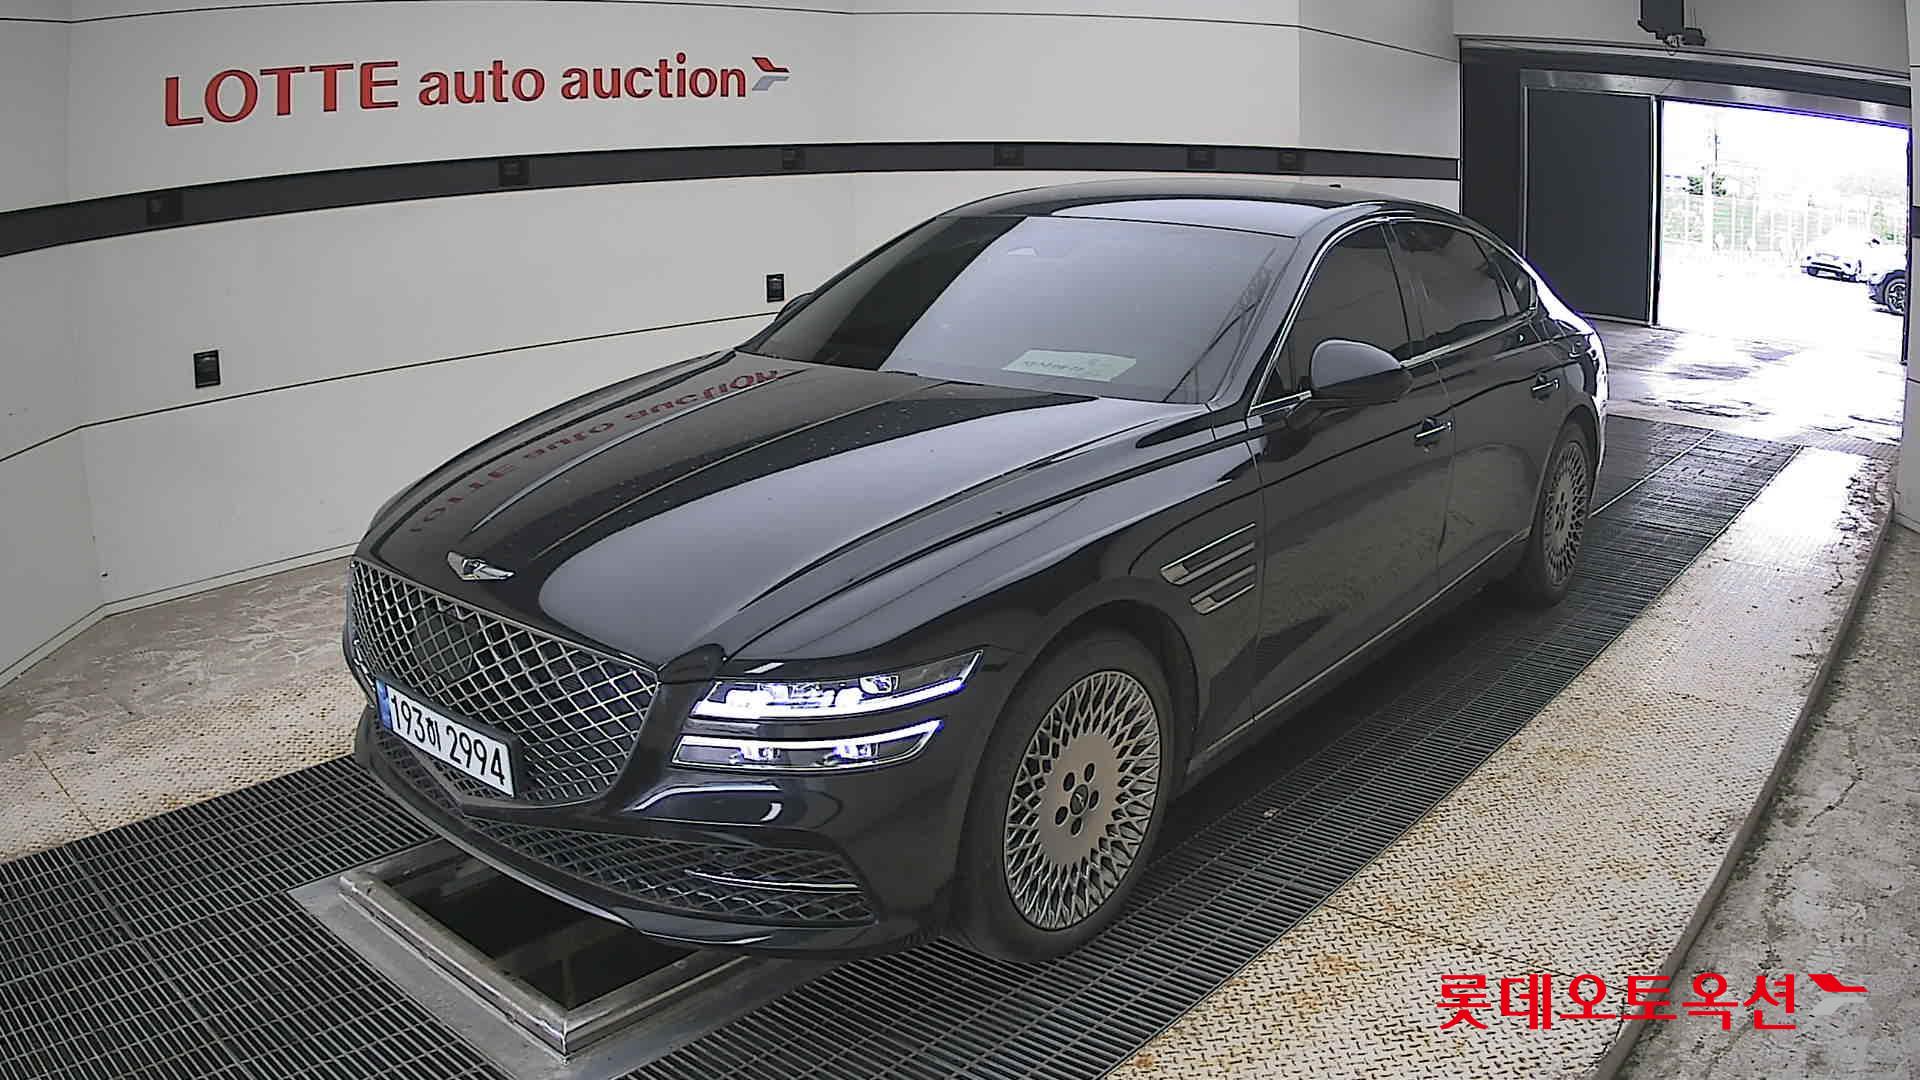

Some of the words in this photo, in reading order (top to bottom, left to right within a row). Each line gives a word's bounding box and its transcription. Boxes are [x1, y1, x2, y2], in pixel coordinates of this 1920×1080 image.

[165, 60, 399, 127] LOTTE
[418, 59, 546, 106] auto
[560, 52, 748, 99] auction
[446, 724, 505, 786] 2994
